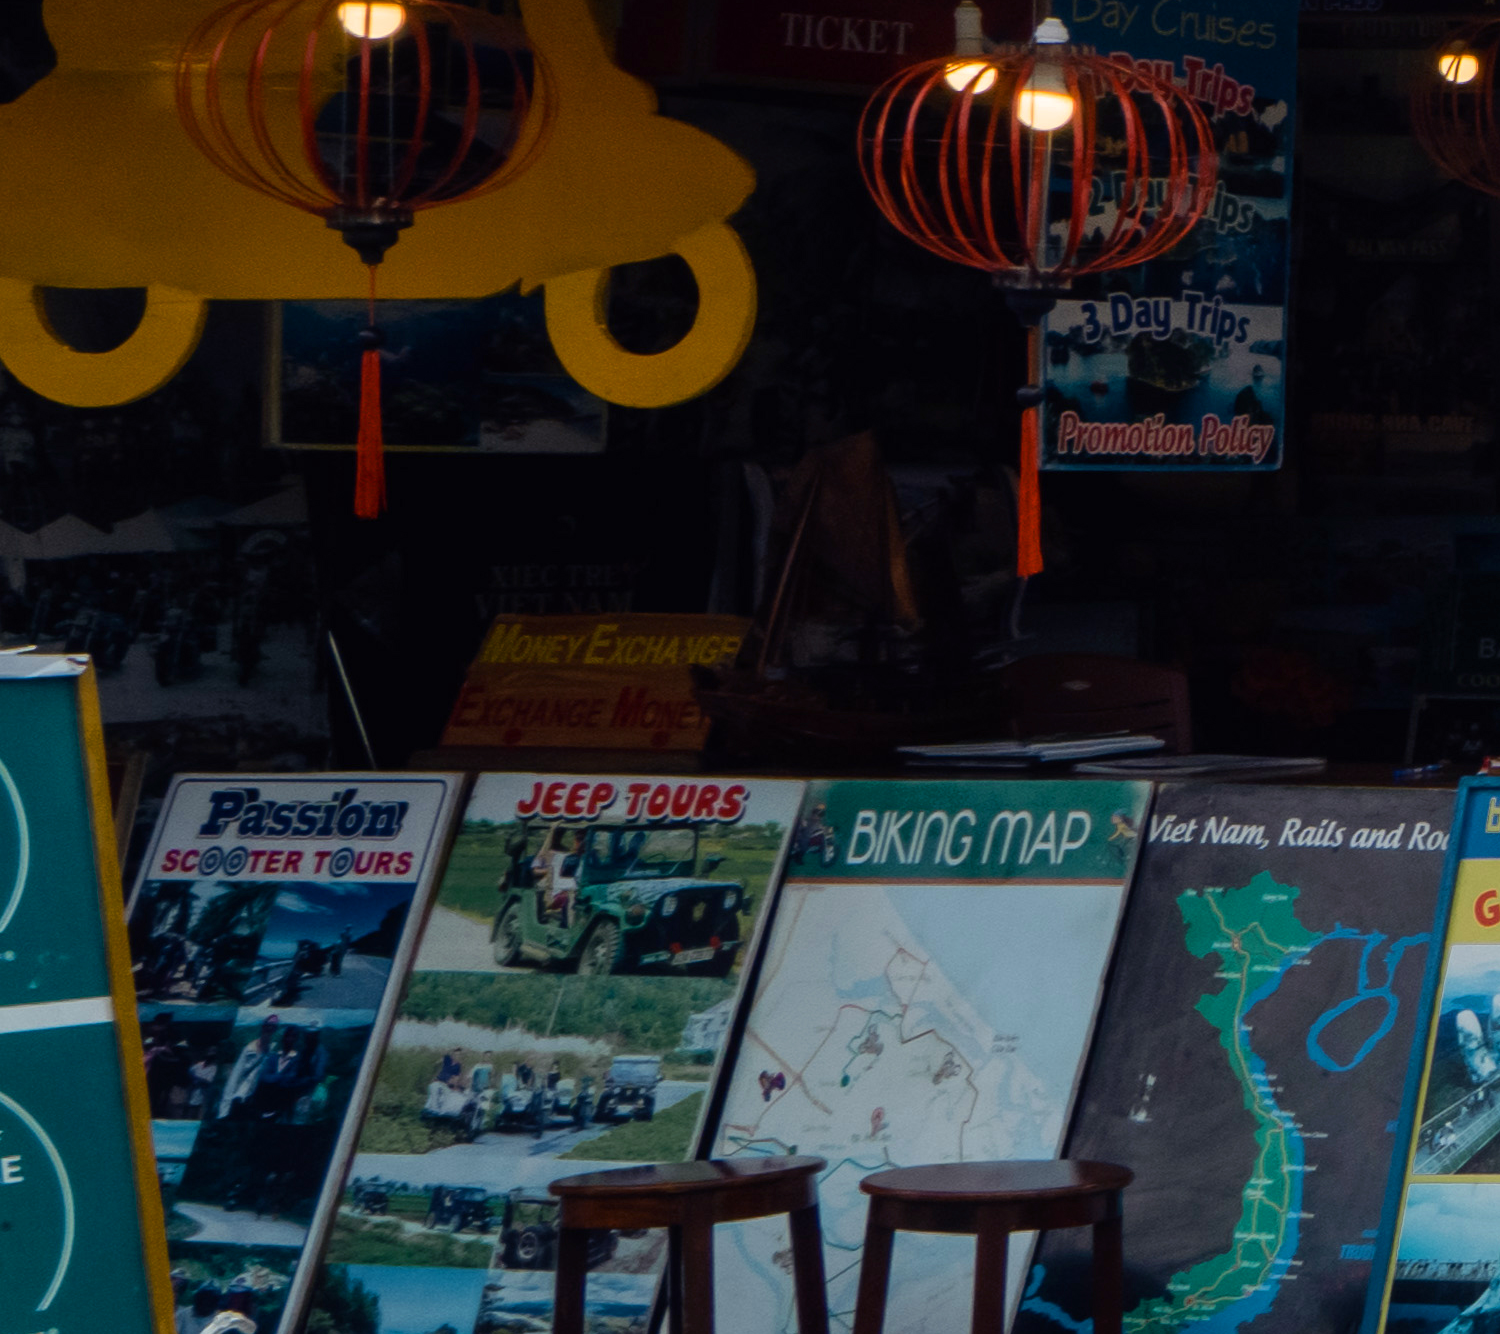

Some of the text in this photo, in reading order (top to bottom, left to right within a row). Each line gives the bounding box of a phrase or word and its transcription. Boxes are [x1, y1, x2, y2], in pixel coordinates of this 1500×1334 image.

[780, 11, 914, 57] TICKET
[1182, 53, 1257, 117] Trips
[1181, 171, 1257, 235] Tips
[1081, 290, 1251, 346] 3 Day Trips
[1057, 411, 1277, 461] Promotion Policy
[479, 622, 586, 665] MONEY
[453, 685, 606, 728] EXCHANGE
[197, 786, 410, 841] Passion
[515, 781, 751, 823] JEEP TOURS
[845, 809, 1093, 867] BIKING MAP
[1148, 813, 1198, 845] Viet
[1200, 817, 1271, 849] Nam,
[1278, 817, 1344, 850] Rails
[1349, 822, 1406, 851] and
[161, 846, 415, 879] SCOOTER TOURS
